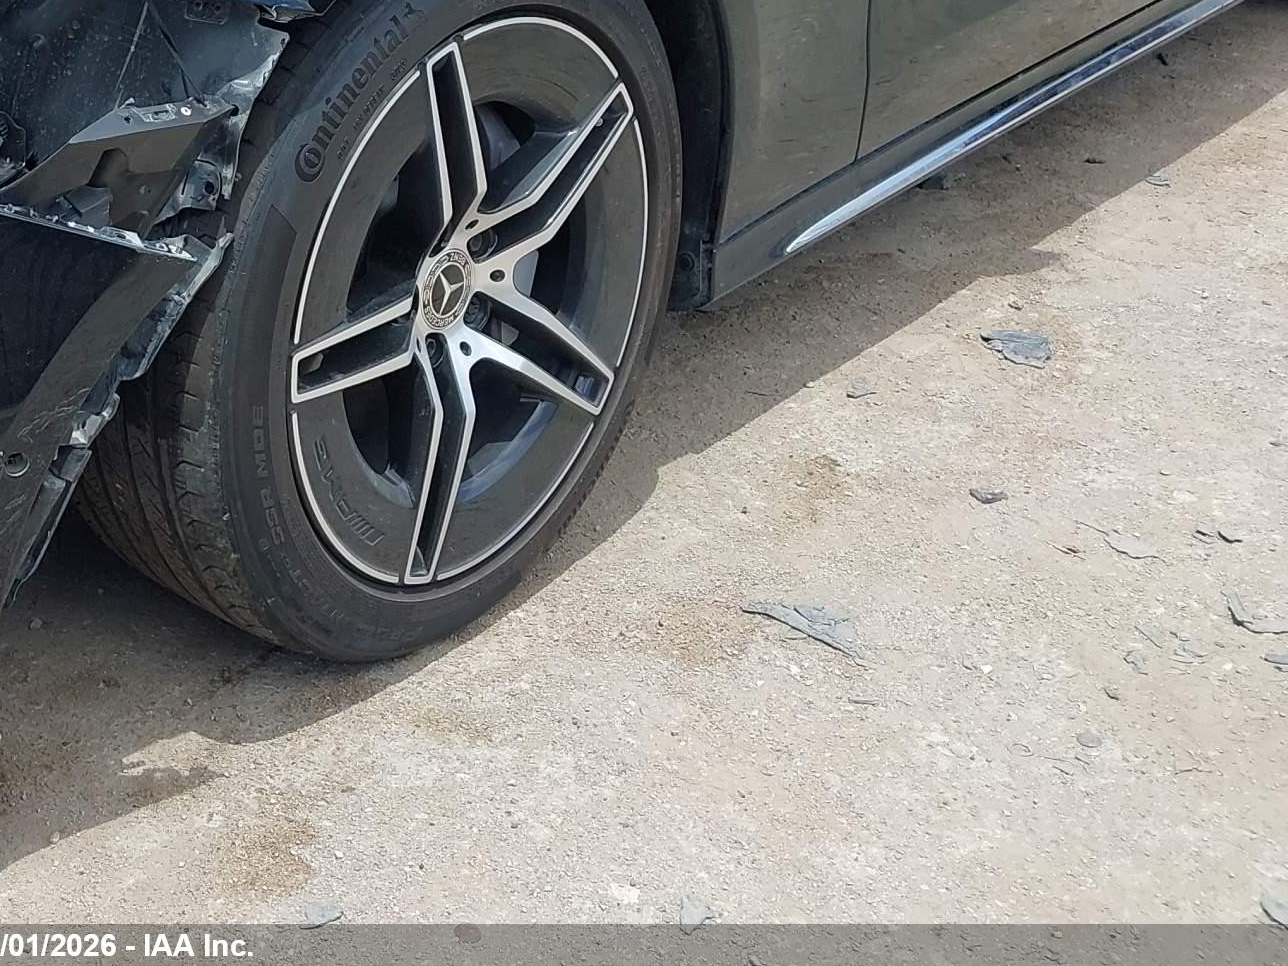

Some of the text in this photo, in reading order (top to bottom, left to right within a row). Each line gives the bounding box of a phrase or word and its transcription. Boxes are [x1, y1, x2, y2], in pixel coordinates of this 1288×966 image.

[295, 13, 411, 183] Continental
[450, 252, 467, 266] BENZ
[424, 305, 455, 328] MERCEDES
[252, 405, 269, 479] MOE
